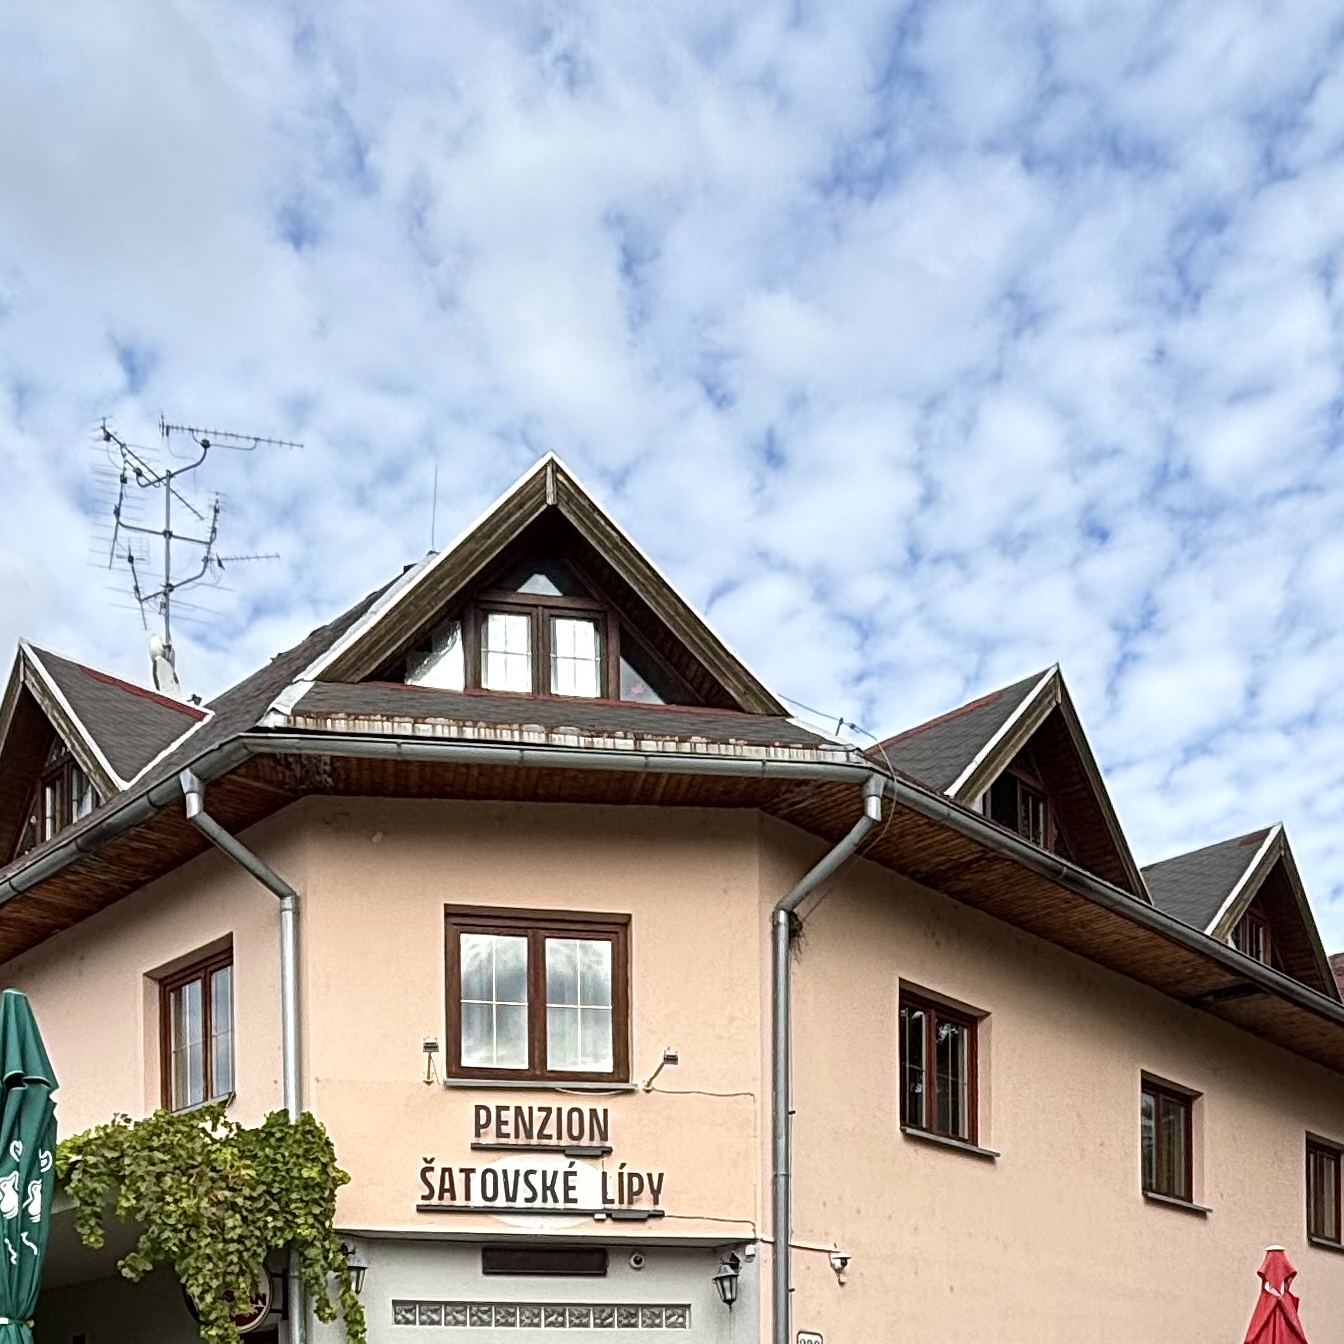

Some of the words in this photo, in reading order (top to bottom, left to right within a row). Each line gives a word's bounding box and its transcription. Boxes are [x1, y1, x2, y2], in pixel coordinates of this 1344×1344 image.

[474, 1104, 609, 1142] PENZION
[420, 1157, 578, 1204] ŠATOVSKÉ
[602, 1162, 665, 1205] LÍPY
